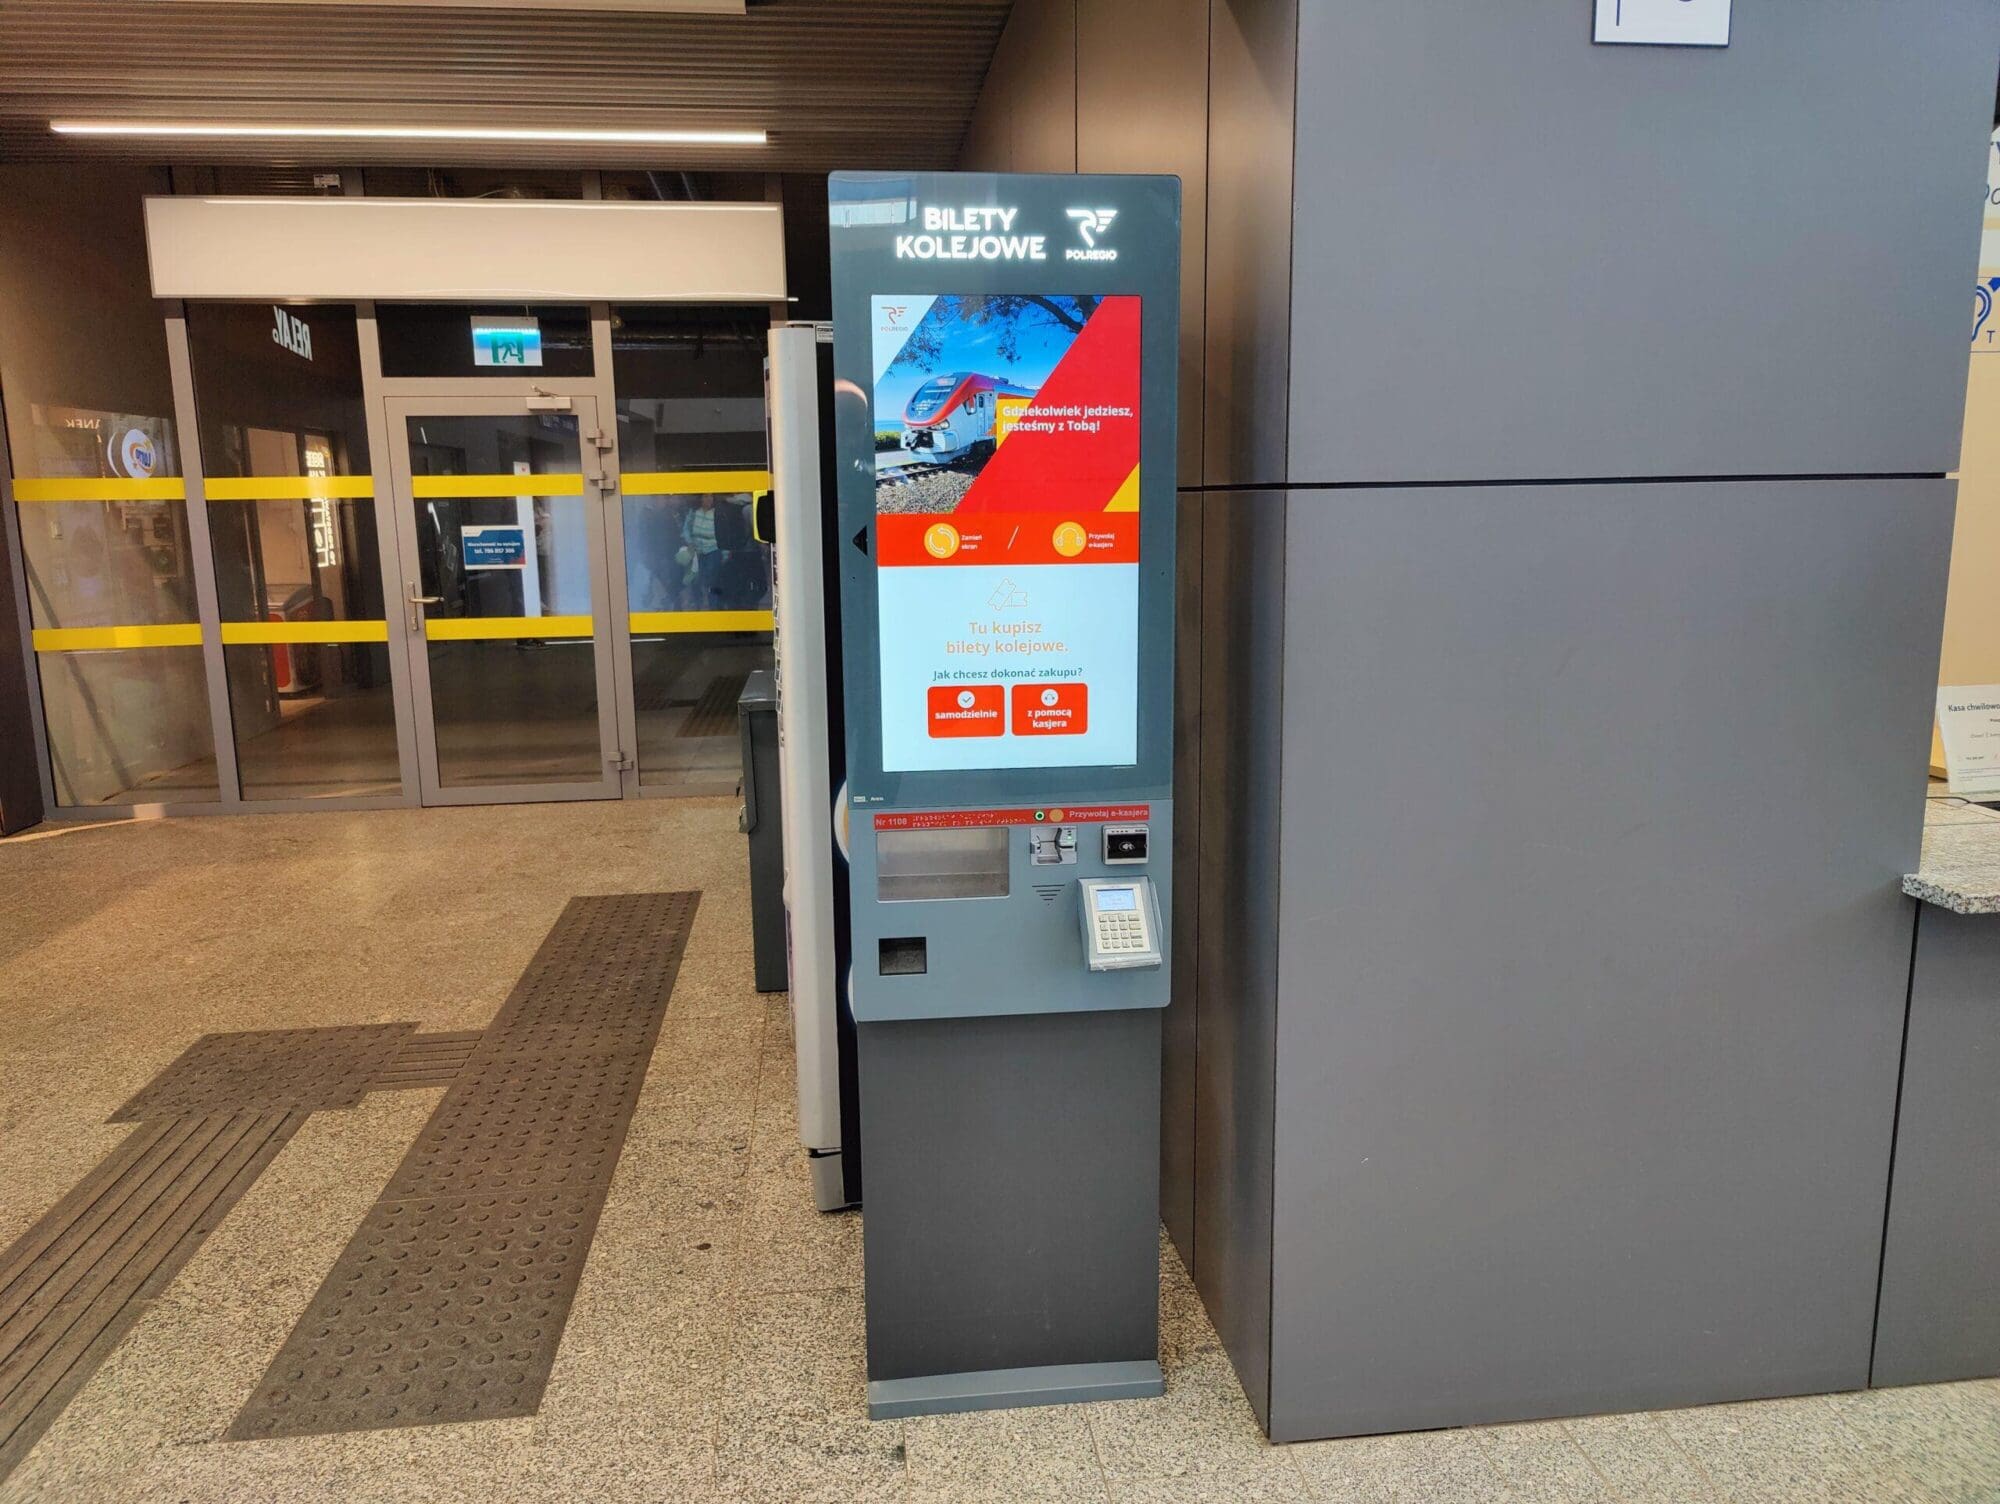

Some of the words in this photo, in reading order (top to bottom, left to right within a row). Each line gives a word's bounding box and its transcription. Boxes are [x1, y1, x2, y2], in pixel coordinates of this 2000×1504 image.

[924, 207, 1018, 231] BILETY
[896, 235, 1047, 260] KOLEJOWE
[1065, 249, 1118, 261] POLREGIO
[1002, 405, 1082, 417] Gdziekolwiek
[1083, 405, 1134, 419] jedziesz,
[1001, 421, 1056, 434] jesteśmy
[1059, 423, 1065, 431] z
[1067, 420, 1101, 434] Tobą!
[969, 622, 987, 634] Tu
[992, 621, 1042, 636] kupisz
[946, 641, 990, 656] bilety
[995, 640, 1068, 655] kolejowe.
[933, 670, 950, 681] Jak
[953, 670, 988, 679] chcesz
[991, 667, 1036, 678] dokonać
[1038, 667, 1083, 679] zakupu?
[935, 709, 998, 720] samodzielnie
[1035, 708, 1072, 720] pomocą
[1032, 719, 1067, 729] kasjera
[1069, 810, 1110, 819] Przywołaj
[1111, 808, 1149, 817] e-kasjera
